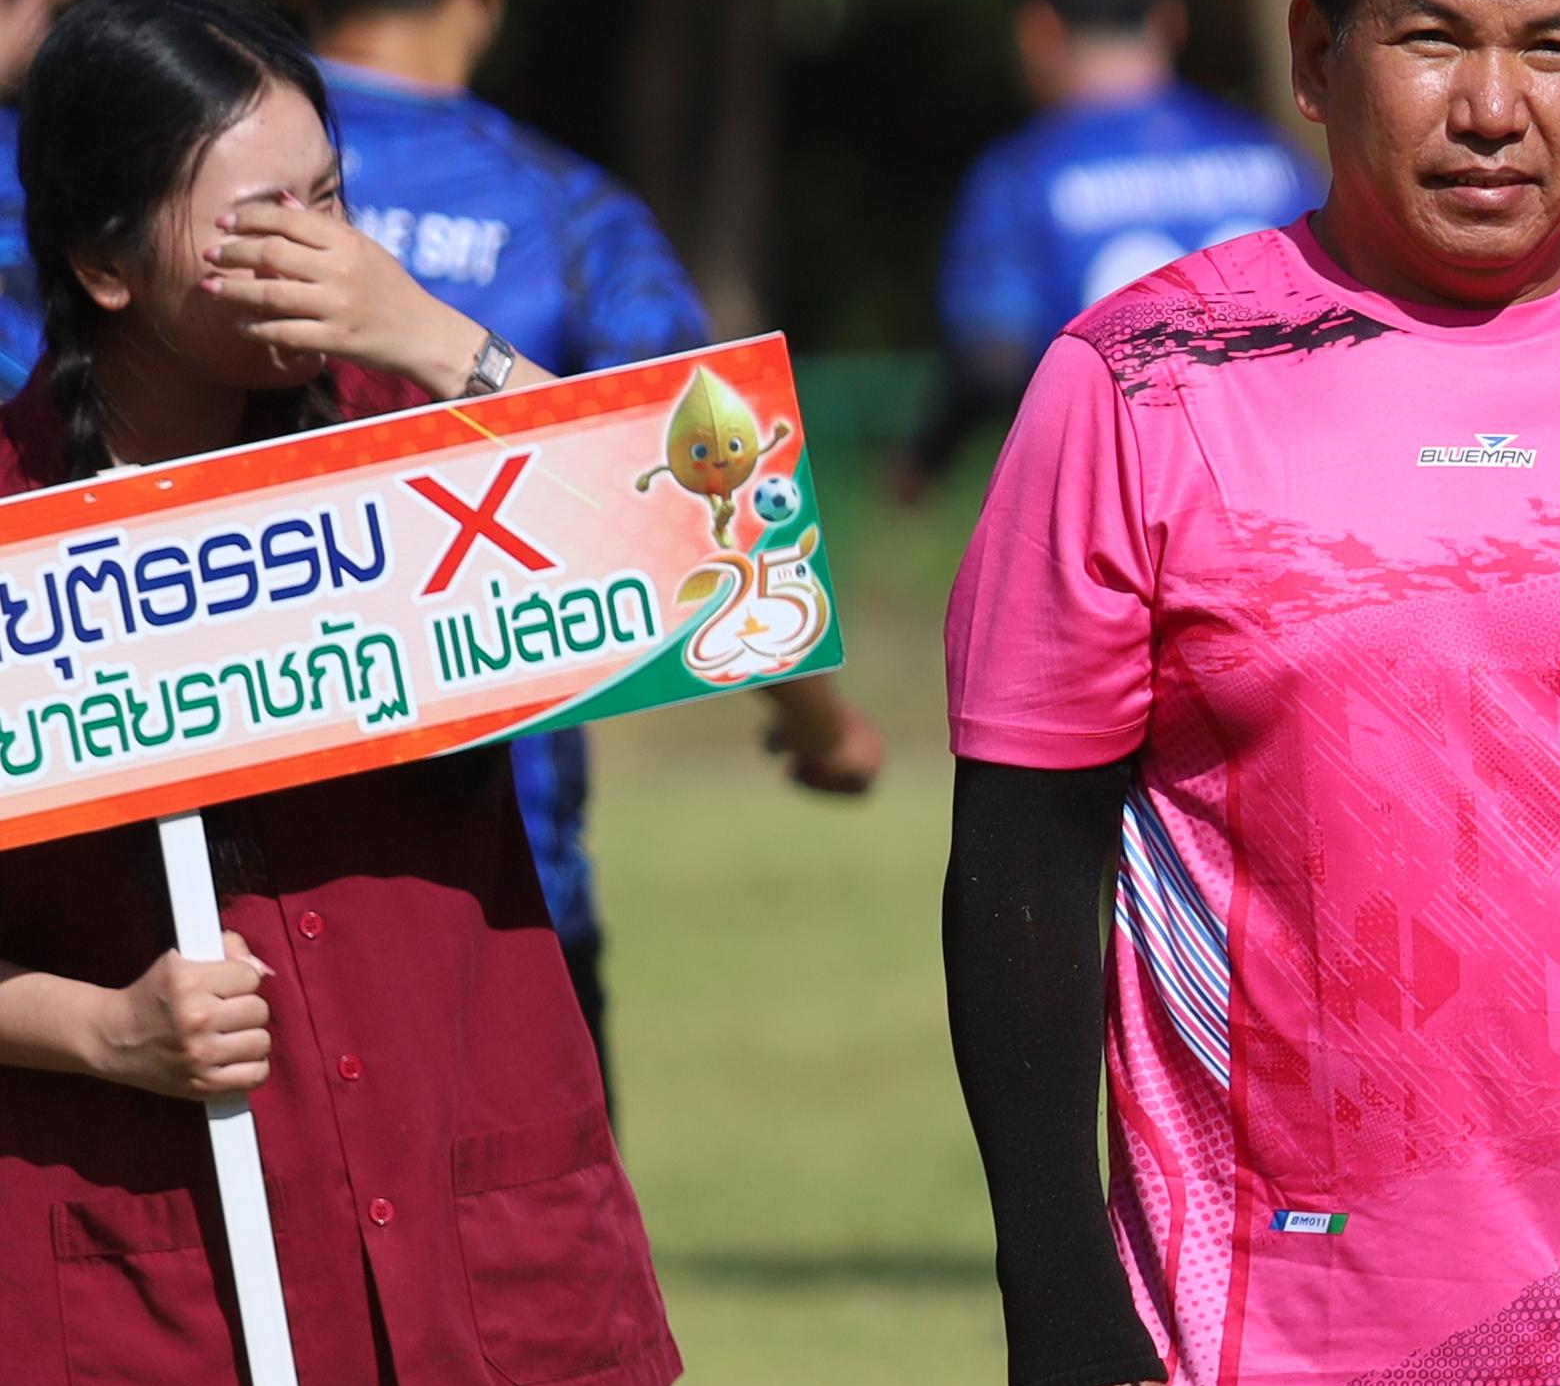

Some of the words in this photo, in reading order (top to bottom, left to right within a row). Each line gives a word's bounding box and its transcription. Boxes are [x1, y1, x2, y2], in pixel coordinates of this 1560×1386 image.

[1418, 448, 1534, 465] BLUEMAN
[0, 502, 385, 680] ยุติธรรม
[407, 452, 557, 596] X
[434, 577, 656, 681] แม่สอด
[1290, 1216, 1327, 1227] BM011
